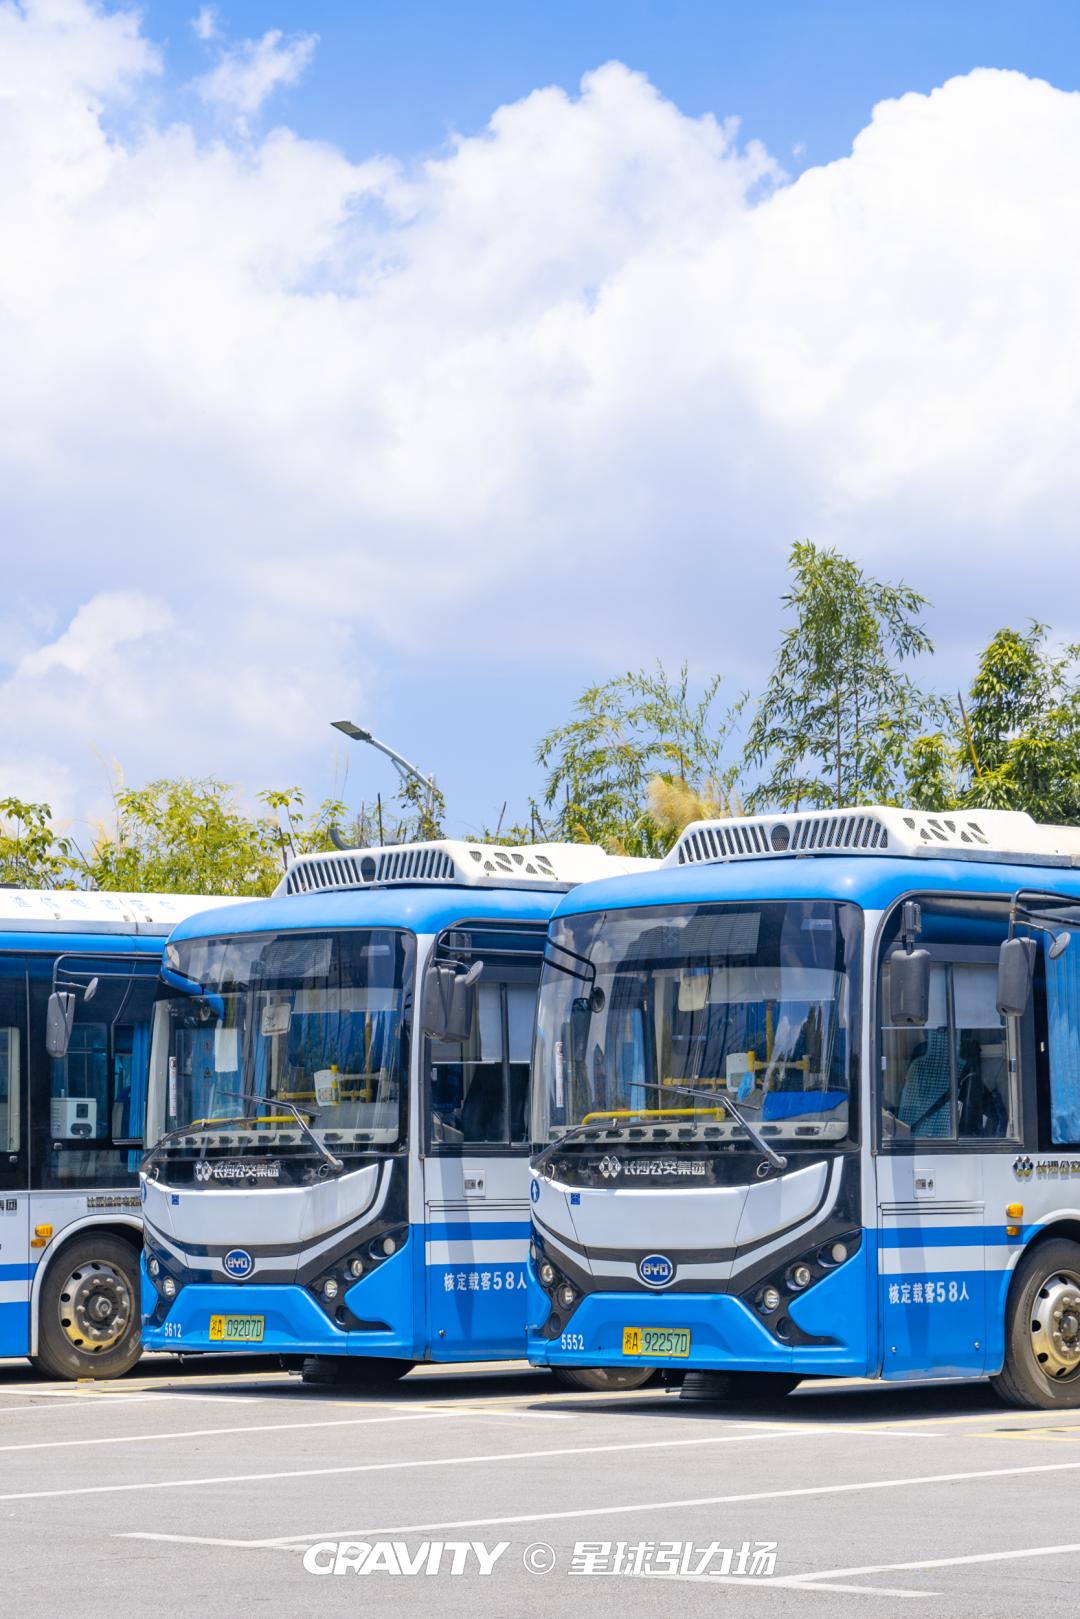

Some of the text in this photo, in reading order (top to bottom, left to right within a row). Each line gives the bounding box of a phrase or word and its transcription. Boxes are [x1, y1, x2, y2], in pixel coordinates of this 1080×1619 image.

[228, 1256, 248, 1269] BYD
[643, 1262, 669, 1276] BYD
[164, 1323, 182, 1338] 5612
[561, 1333, 584, 1351] 5552
